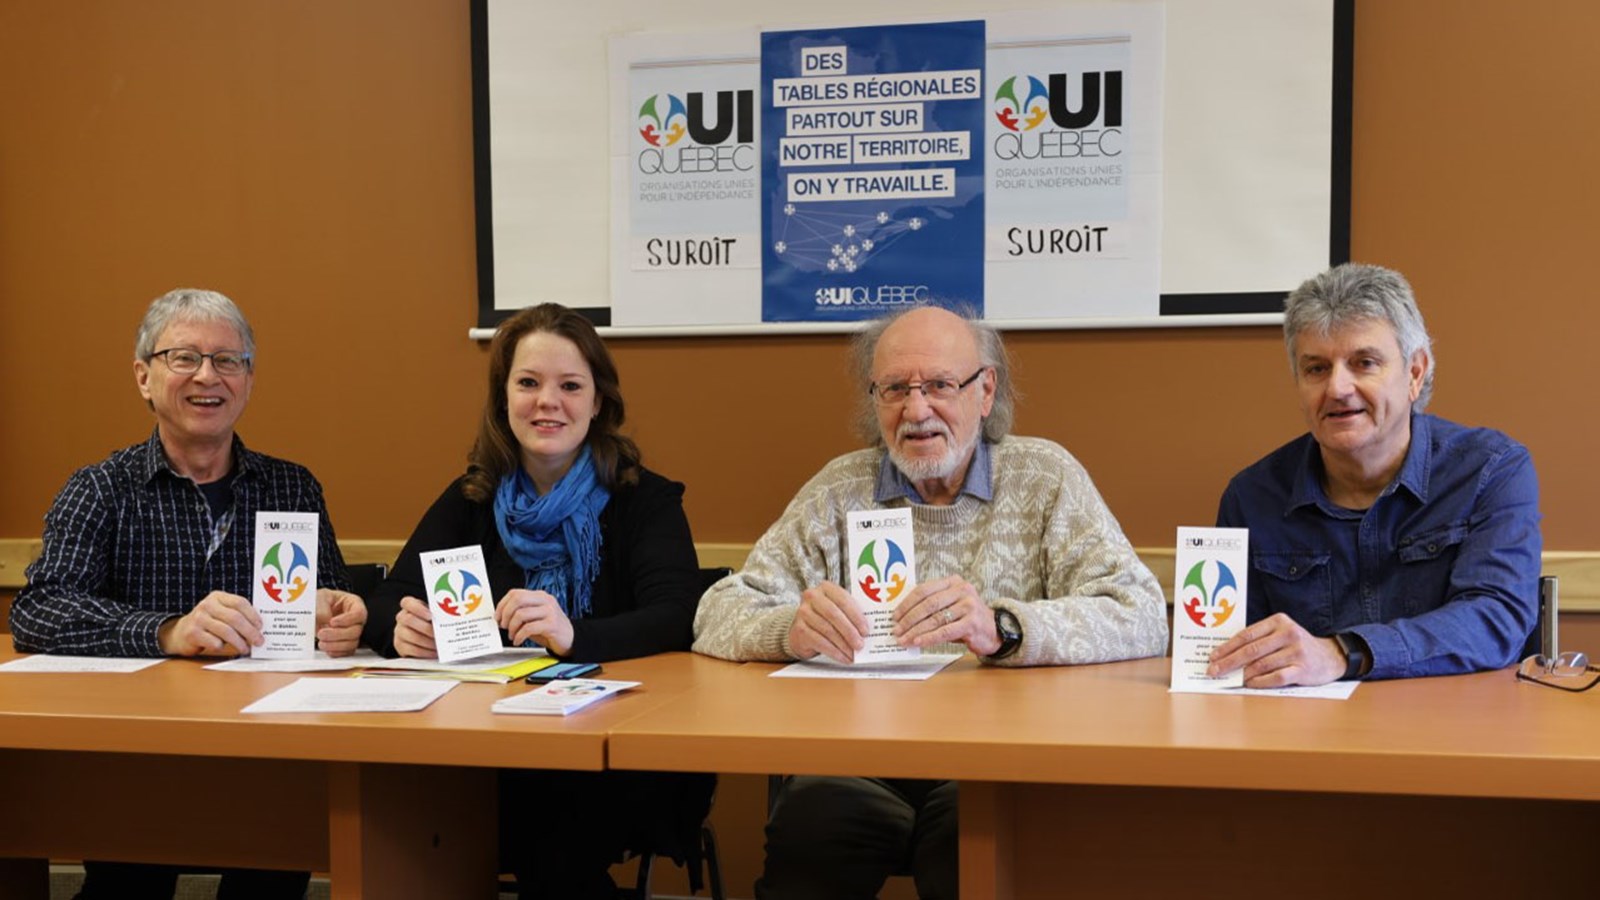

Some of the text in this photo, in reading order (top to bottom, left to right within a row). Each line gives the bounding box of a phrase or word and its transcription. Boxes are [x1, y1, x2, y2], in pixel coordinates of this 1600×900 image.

[805, 53, 844, 70] DES
[778, 77, 976, 101] TABLES RÉGIONALES
[791, 109, 918, 130] PARTOUT SUR
[783, 143, 848, 160] NOTRE
[859, 138, 963, 157] TERRITOIRE,
[994, 128, 1122, 161] QUÉBEC
[638, 144, 754, 174] QUÉBEC
[995, 164, 1123, 179] ORGANISATIONS UNIES
[639, 178, 755, 193] ORGANISATIONS UNIES
[793, 174, 949, 195] ON Y TRAVAILLE.
[995, 179, 1026, 190] POUR
[639, 191, 667, 202] POUR
[1008, 225, 1109, 257] SUROÎT
[647, 237, 737, 267] SUROÎT
